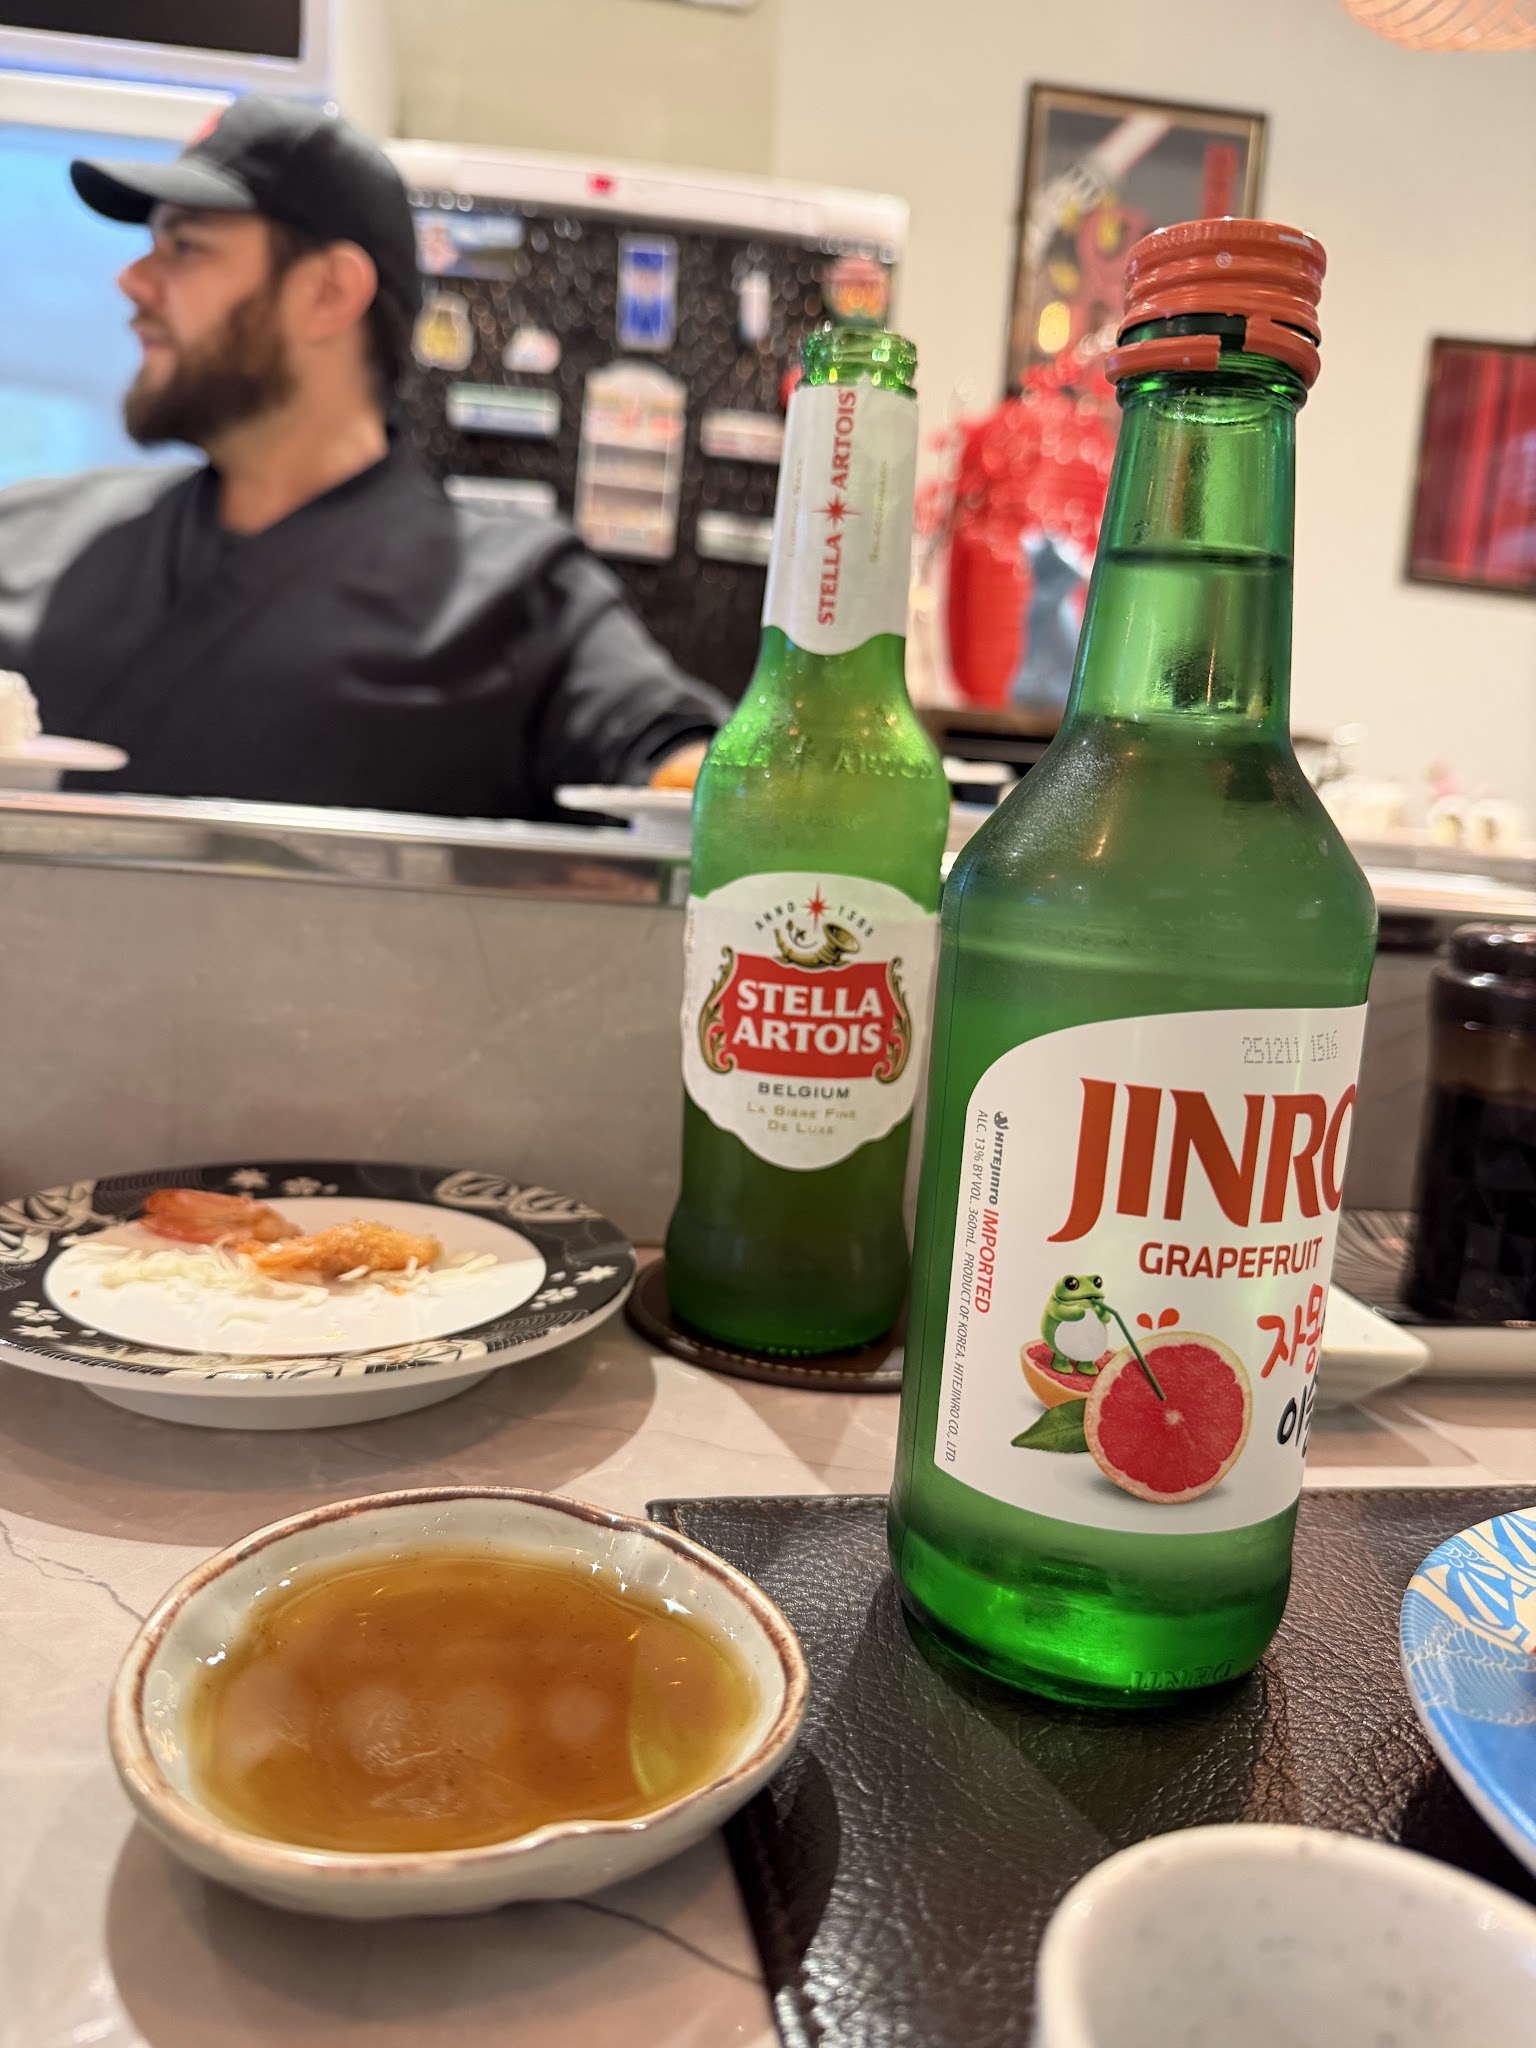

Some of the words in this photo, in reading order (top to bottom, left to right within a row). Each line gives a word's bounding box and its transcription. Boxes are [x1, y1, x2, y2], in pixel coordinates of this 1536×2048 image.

[817, 534, 842, 627] STELLA
[831, 391, 856, 491] ARTOIS
[755, 901, 796, 931] ANNO
[736, 979, 883, 1018] STELLA
[732, 1017, 882, 1055] ARTOIS
[1241, 1036, 1301, 1064] 251211
[1310, 1029, 1338, 1062] 1516
[758, 1082, 850, 1099] BELGIUM
[976, 1109, 988, 1133] ALC.
[974, 1138, 985, 1161] 13%
[971, 1164, 983, 1180] BY
[969, 1180, 982, 1204] VOL.
[975, 1208, 999, 1314] IMPORTED
[1139, 1236, 1323, 1279] GRAPEFRUIT
[960, 1252, 974, 1305] PRODUCT
[958, 1305, 970, 1321] OF
[954, 1321, 969, 1359] KOREA.
[949, 1362, 964, 1418] HITEJINRO
[944, 1441, 956, 1462] LTD.
